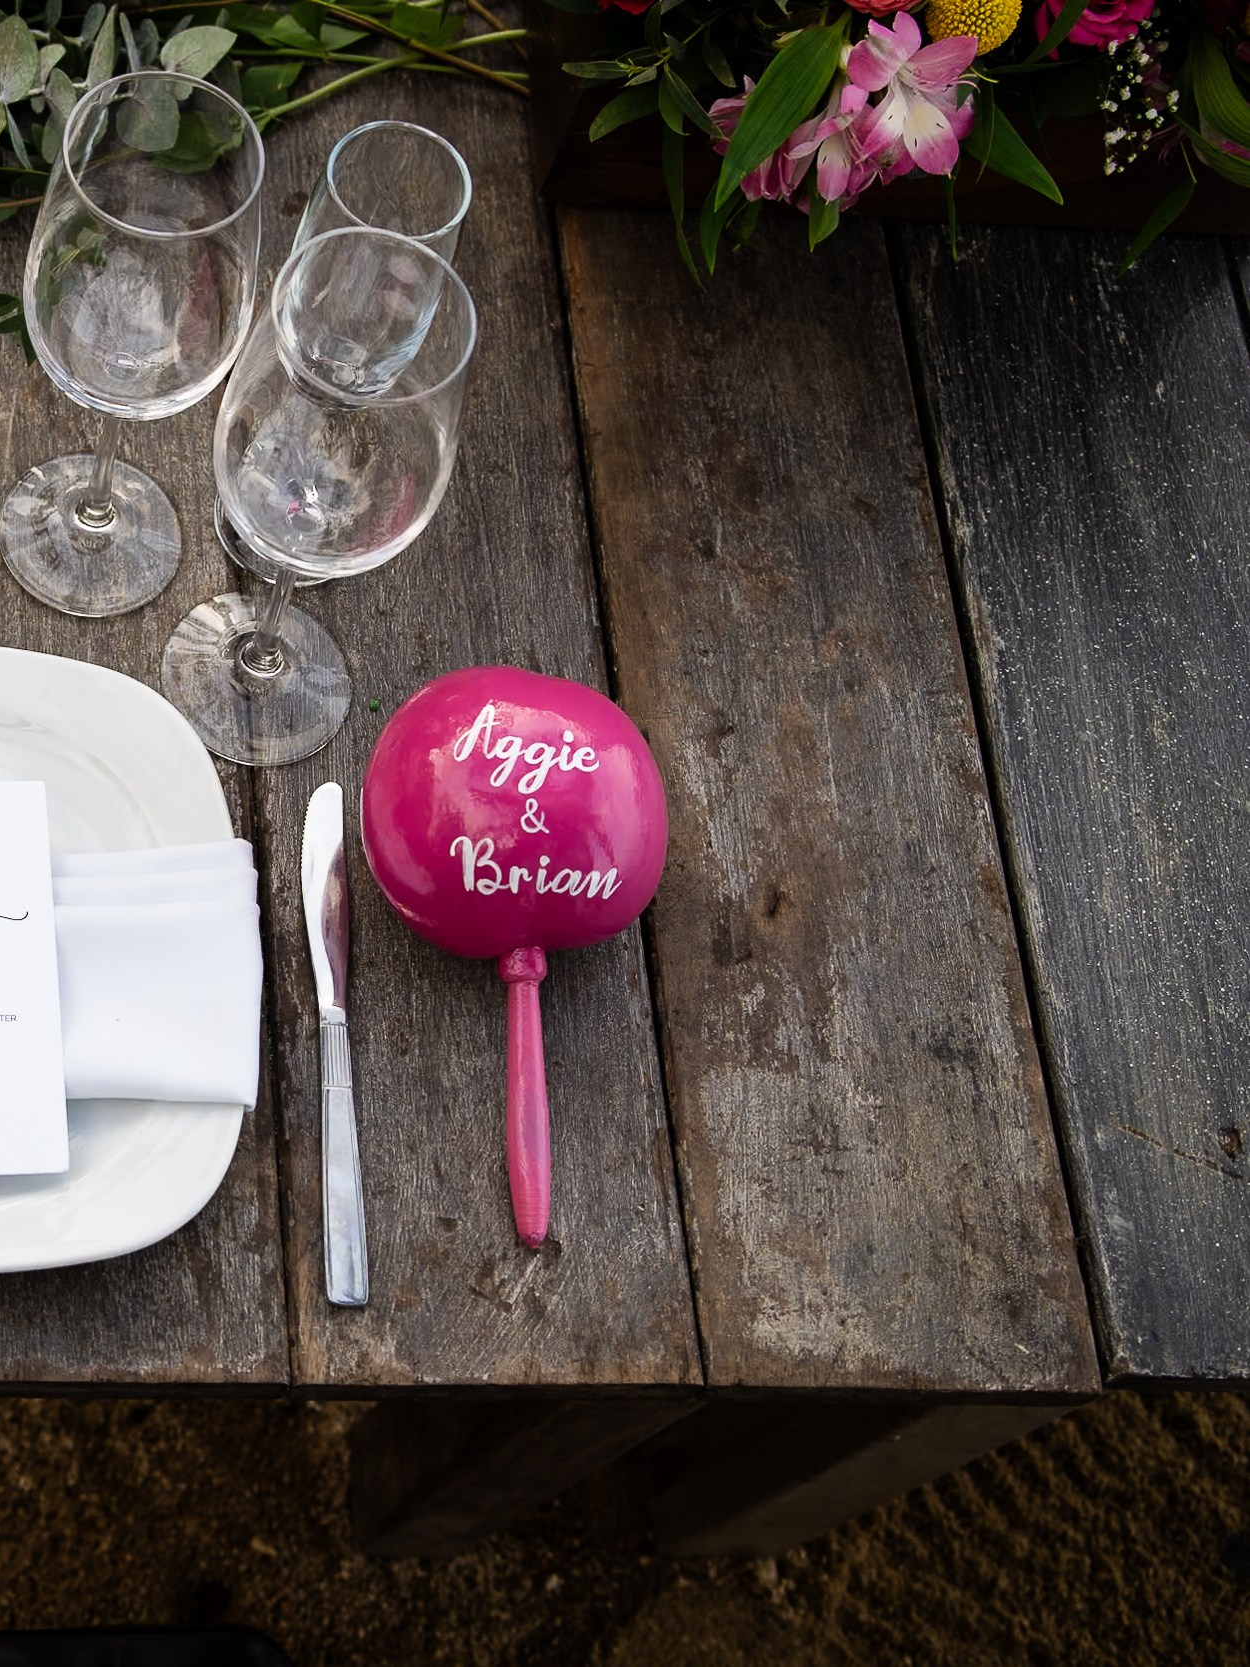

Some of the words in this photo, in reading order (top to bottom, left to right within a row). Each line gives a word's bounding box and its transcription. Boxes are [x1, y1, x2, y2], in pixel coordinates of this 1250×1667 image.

[453, 703, 600, 795] Aggie
[519, 797, 550, 834] &
[449, 835, 623, 900] Brian
